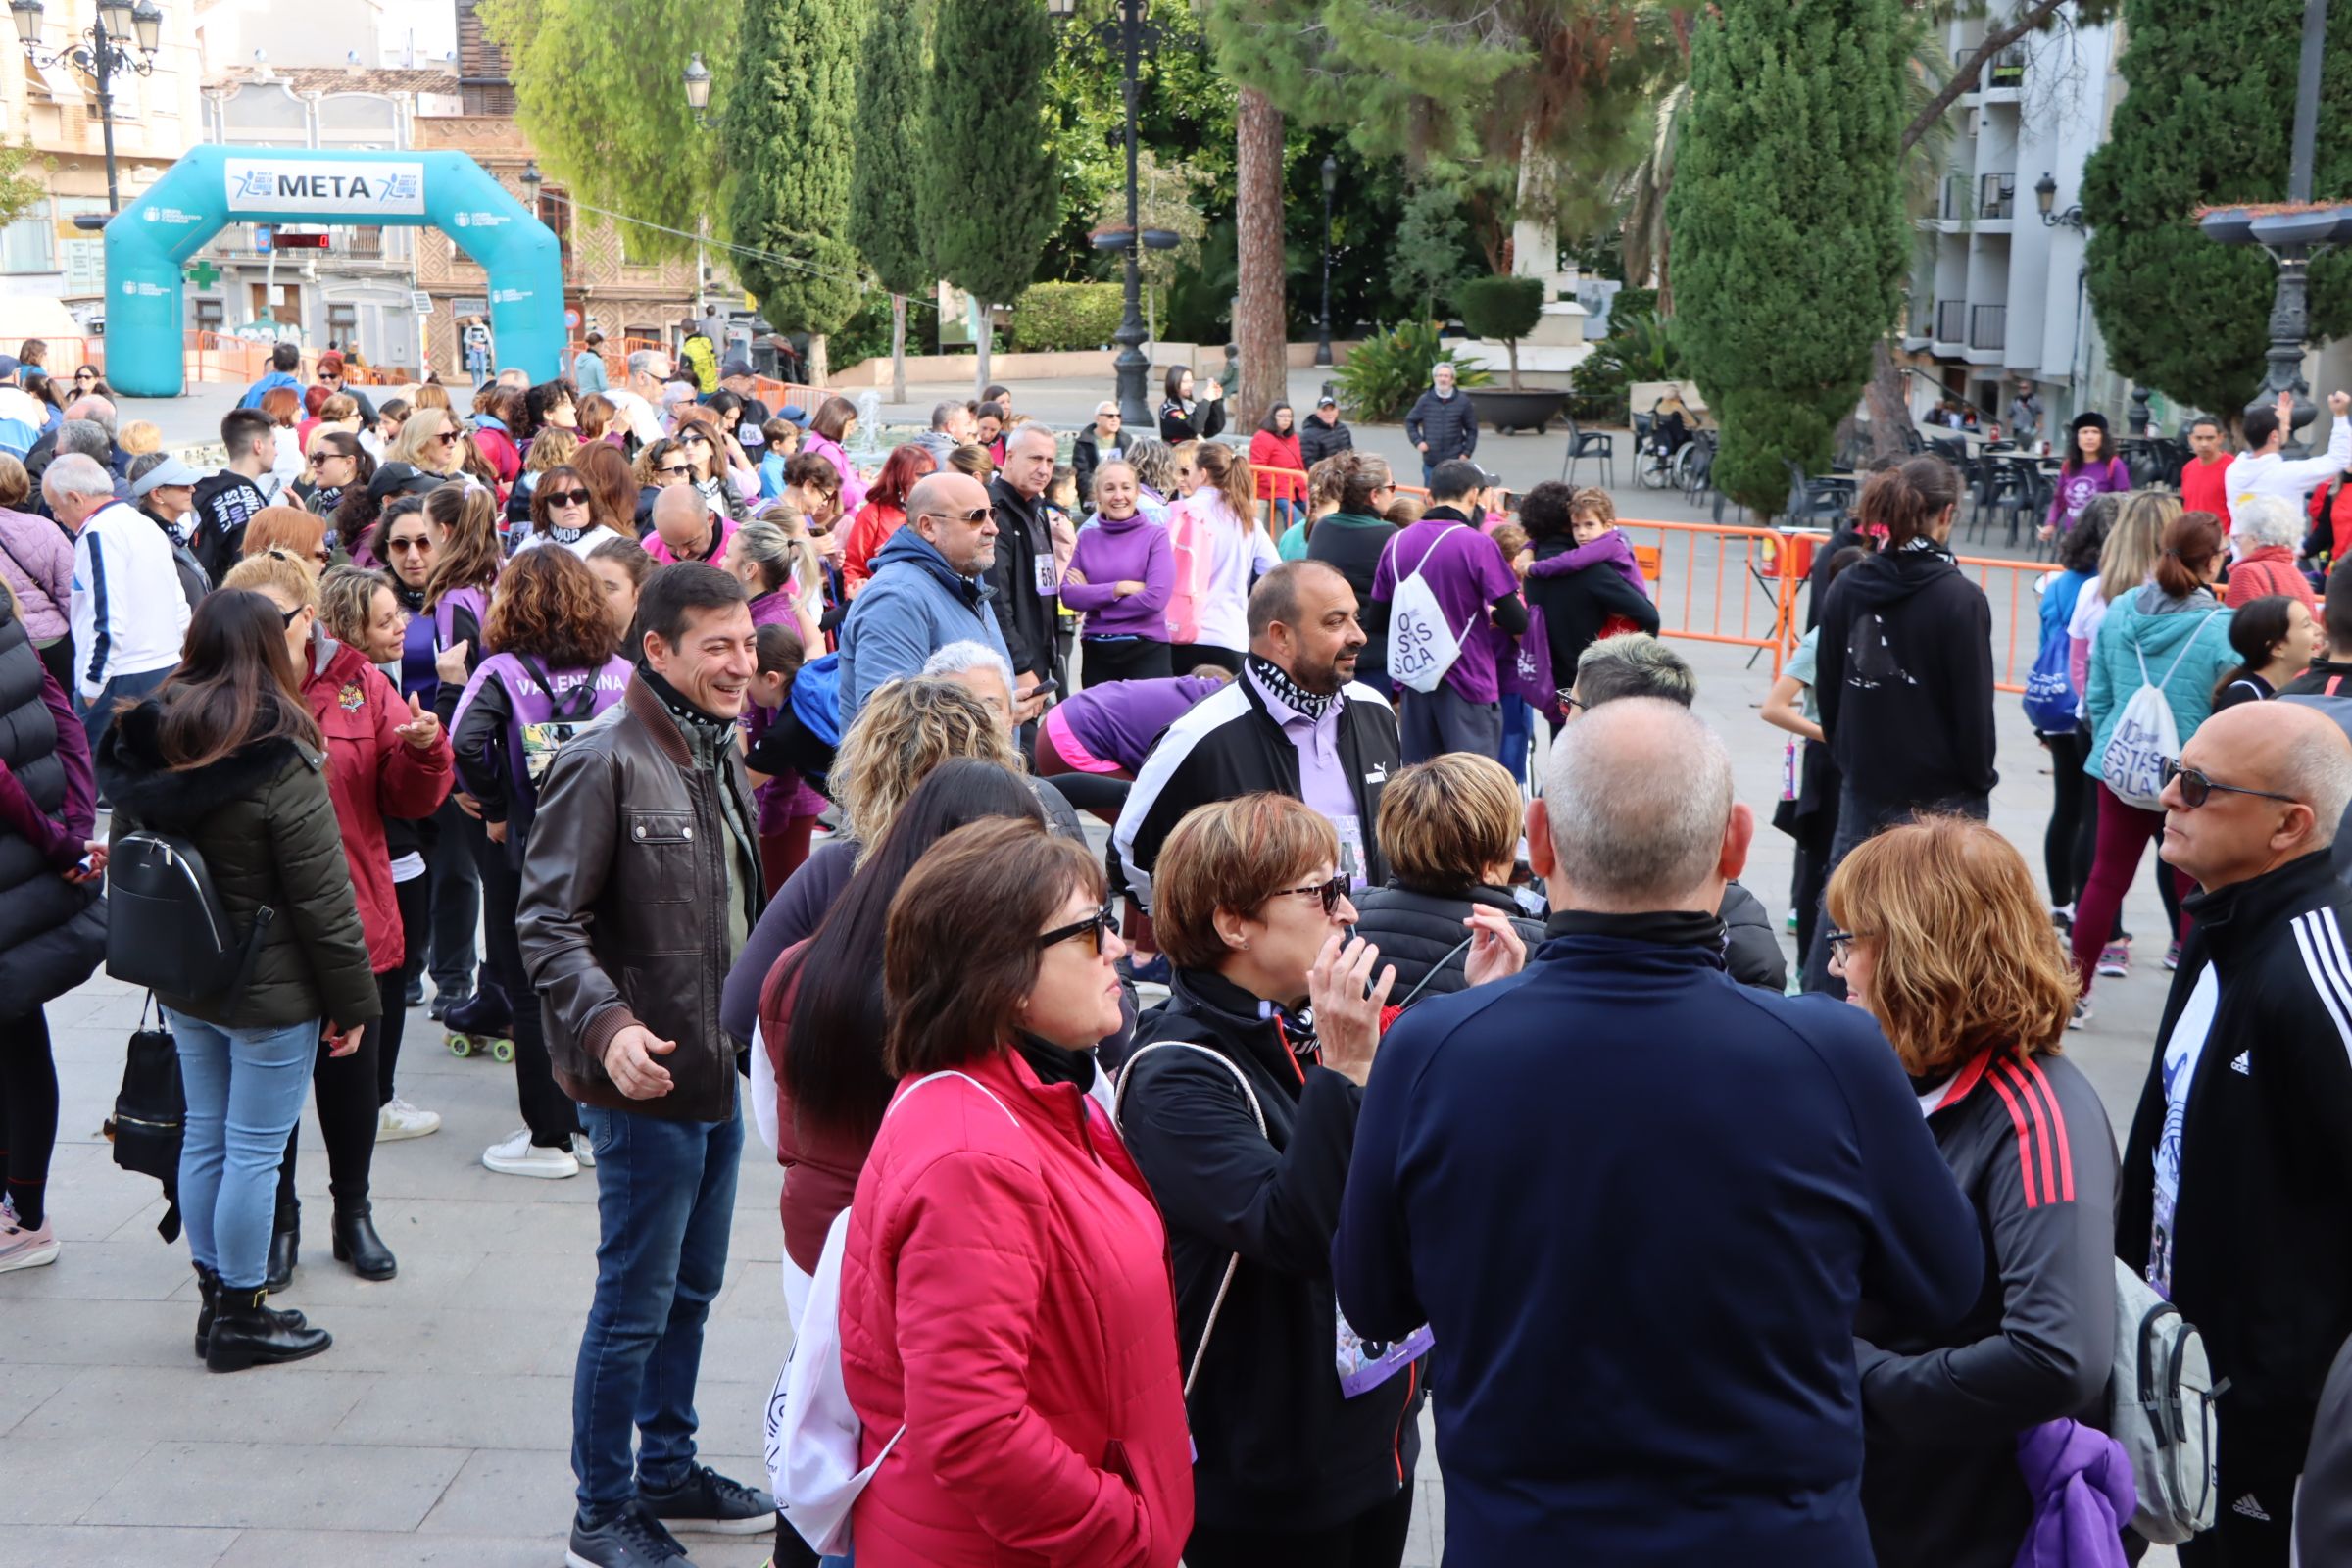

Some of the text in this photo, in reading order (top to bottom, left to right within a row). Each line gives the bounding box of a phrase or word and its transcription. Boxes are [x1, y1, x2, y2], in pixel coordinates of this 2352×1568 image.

[278, 174, 370, 198] META
[551, 524, 580, 541] MOR
[2232, 1503, 2271, 1521] adidas
